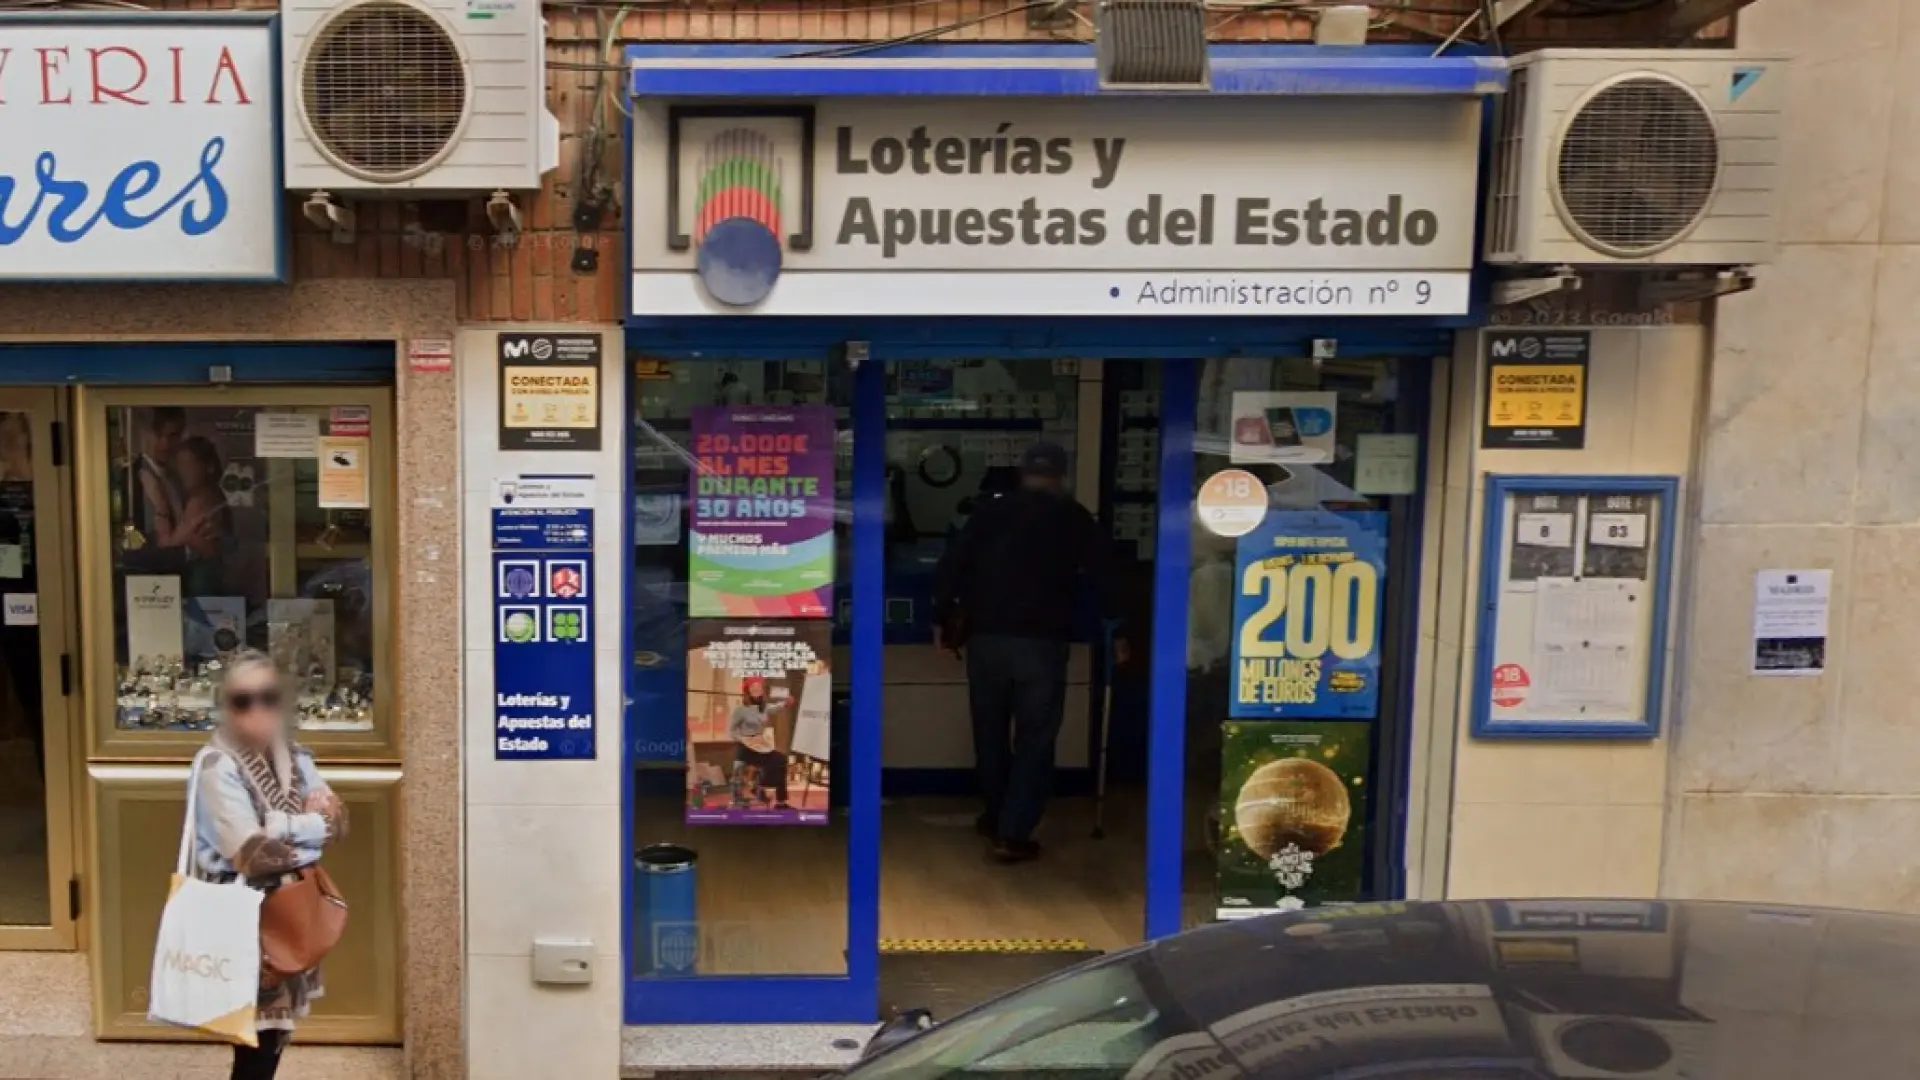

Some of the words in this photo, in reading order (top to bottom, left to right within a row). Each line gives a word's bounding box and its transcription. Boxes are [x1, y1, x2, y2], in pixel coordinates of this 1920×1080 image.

[836, 122, 1072, 174] Loterías
[1091, 137, 1126, 189] y
[836, 196, 1107, 257] Apuestas
[1127, 194, 1215, 245] del
[1235, 194, 1438, 246] Estado
[1137, 279, 1351, 304] Administración
[1415, 280, 1431, 304] 9
[510, 376, 590, 386] CONECTADA
[1497, 375, 1576, 385] CONECTADA
[697, 434, 808, 453] 20.000€
[697, 456, 731, 475] AL
[737, 456, 788, 475] MES
[697, 477, 818, 496] DURANTE
[696, 498, 729, 518] 30
[736, 494, 806, 518] AÑOS
[708, 534, 763, 544] MUCHOS
[1239, 560, 1377, 660] 200
[1239, 659, 1321, 681] MILLONES
[497, 692, 557, 707] Loterías
[560, 695, 571, 710] y
[1239, 681, 1259, 703] DE
[1263, 681, 1317, 703] EUROS
[497, 715, 566, 731] Apuestas
[568, 714, 592, 729] del
[498, 737, 548, 751] Estado
[162, 948, 233, 982] MAGIC
